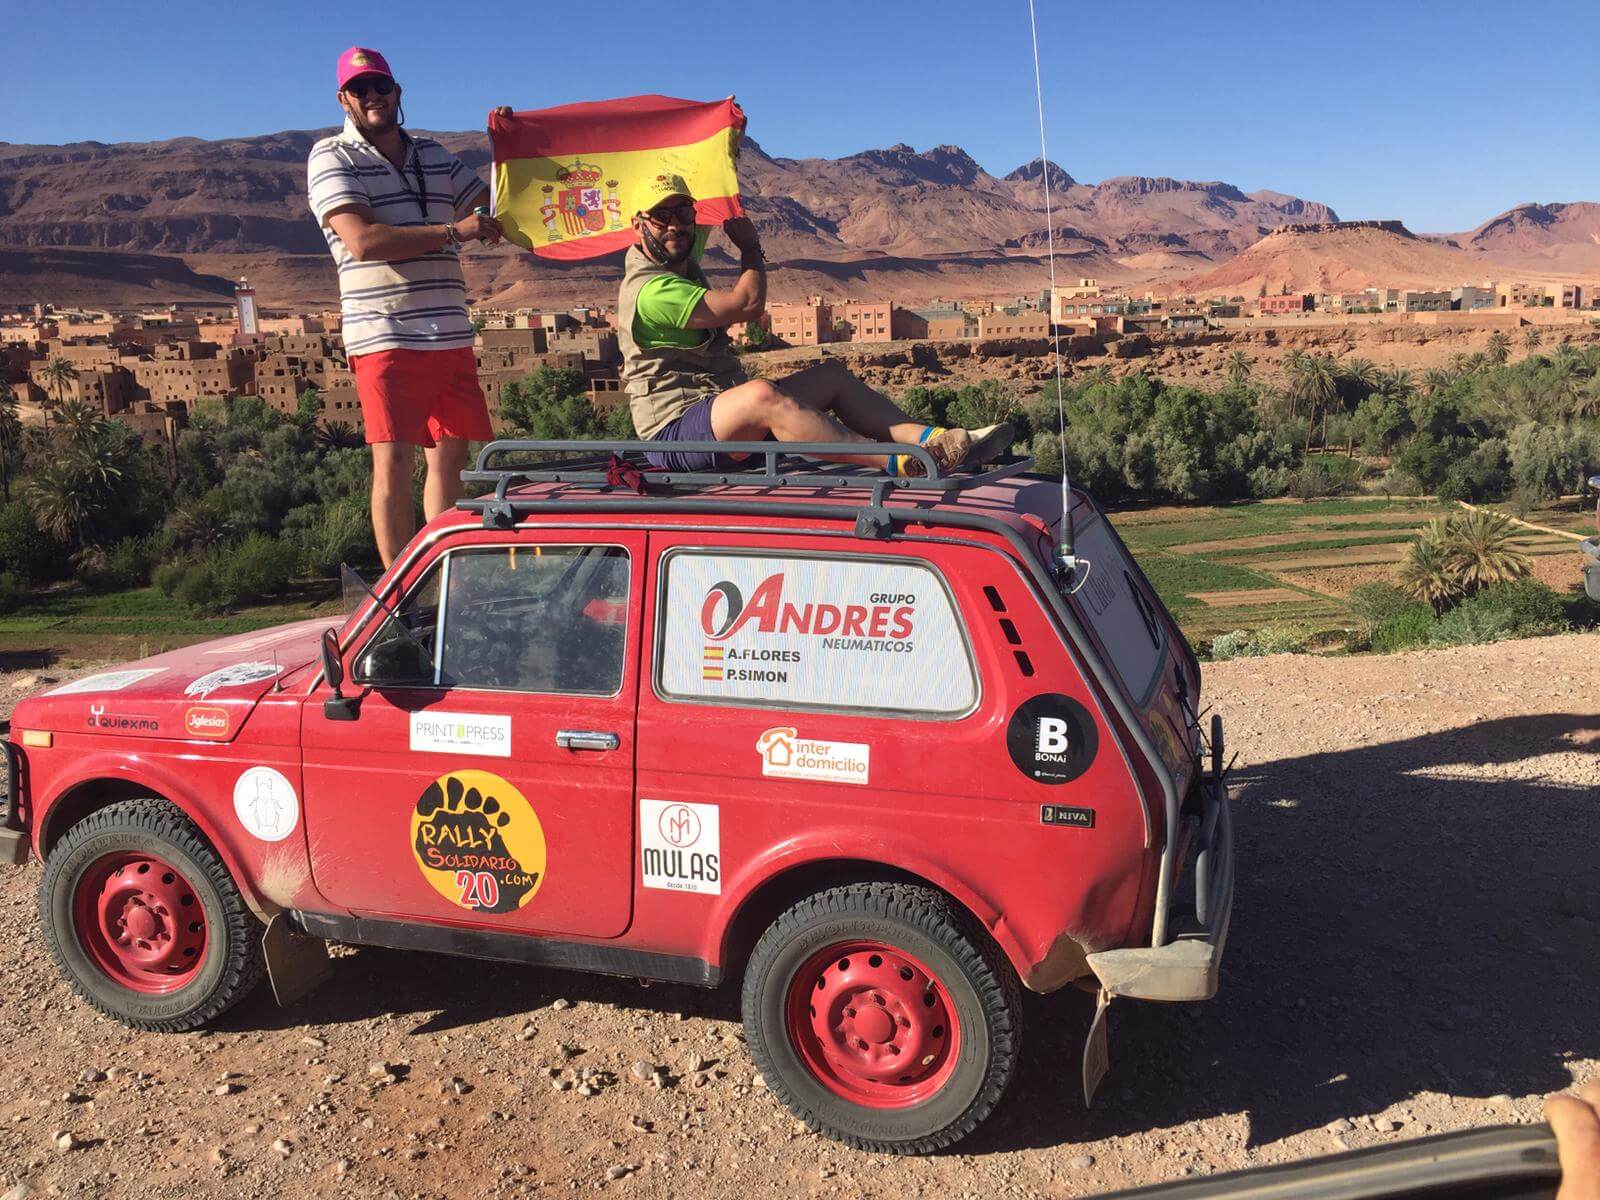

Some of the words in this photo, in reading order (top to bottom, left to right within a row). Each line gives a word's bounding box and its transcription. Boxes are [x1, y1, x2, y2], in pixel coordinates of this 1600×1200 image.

[870, 592, 915, 604] GRUPO
[822, 637, 913, 653] NEUMATICOS
[728, 648, 801, 662] A.FLORES
[727, 669, 787, 683] P.SIMON
[1038, 717, 1068, 754] B
[796, 740, 831, 755] inter
[796, 755, 866, 772] domicilio
[1059, 811, 1088, 821] NIVA
[421, 824, 495, 850] RALLY
[427, 848, 517, 872] SOLIDARIO
[643, 847, 718, 882] MULAS
[456, 869, 499, 908] 20
